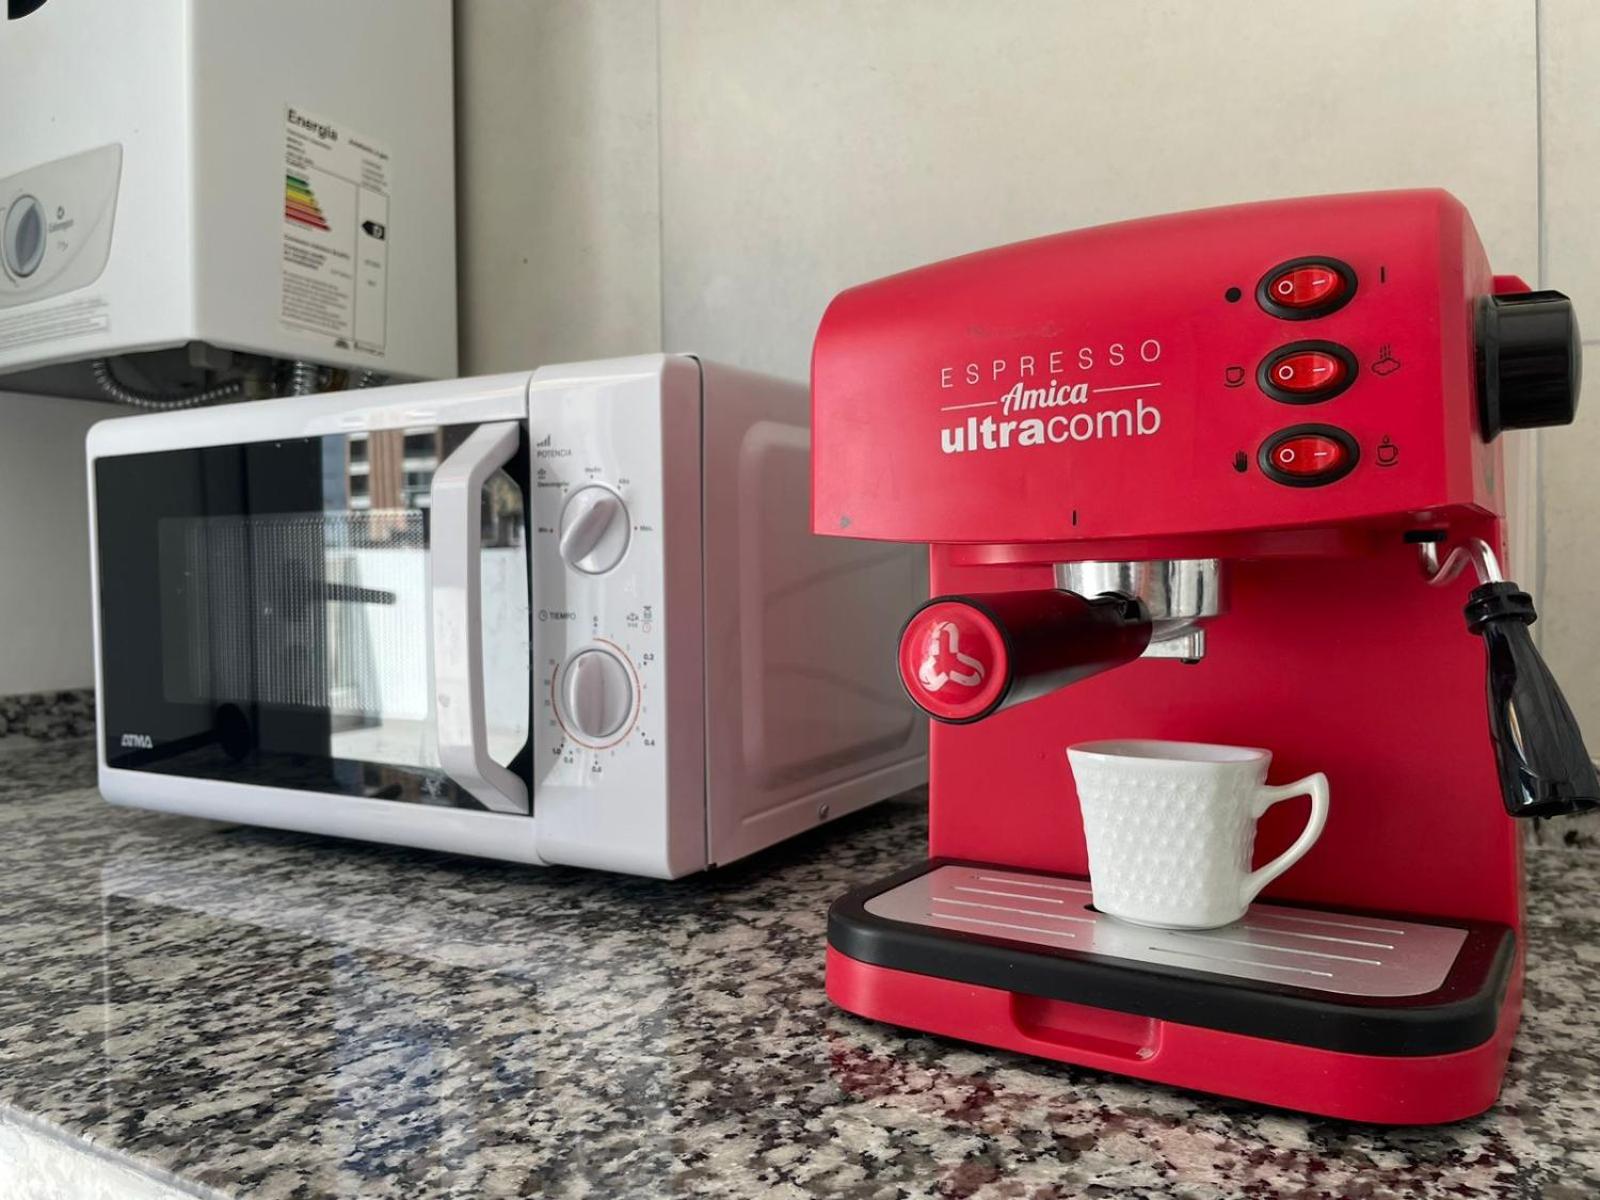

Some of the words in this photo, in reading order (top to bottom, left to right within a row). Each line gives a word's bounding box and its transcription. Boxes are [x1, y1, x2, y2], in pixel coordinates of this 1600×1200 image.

[941, 339, 1161, 388] ESPRESSO
[1000, 379, 1089, 416] Amica
[941, 398, 1161, 454] ultracomb
[536, 449, 572, 458] POTENCIA
[548, 611, 577, 620] TIEMPO
[120, 733, 154, 749] ATMA
